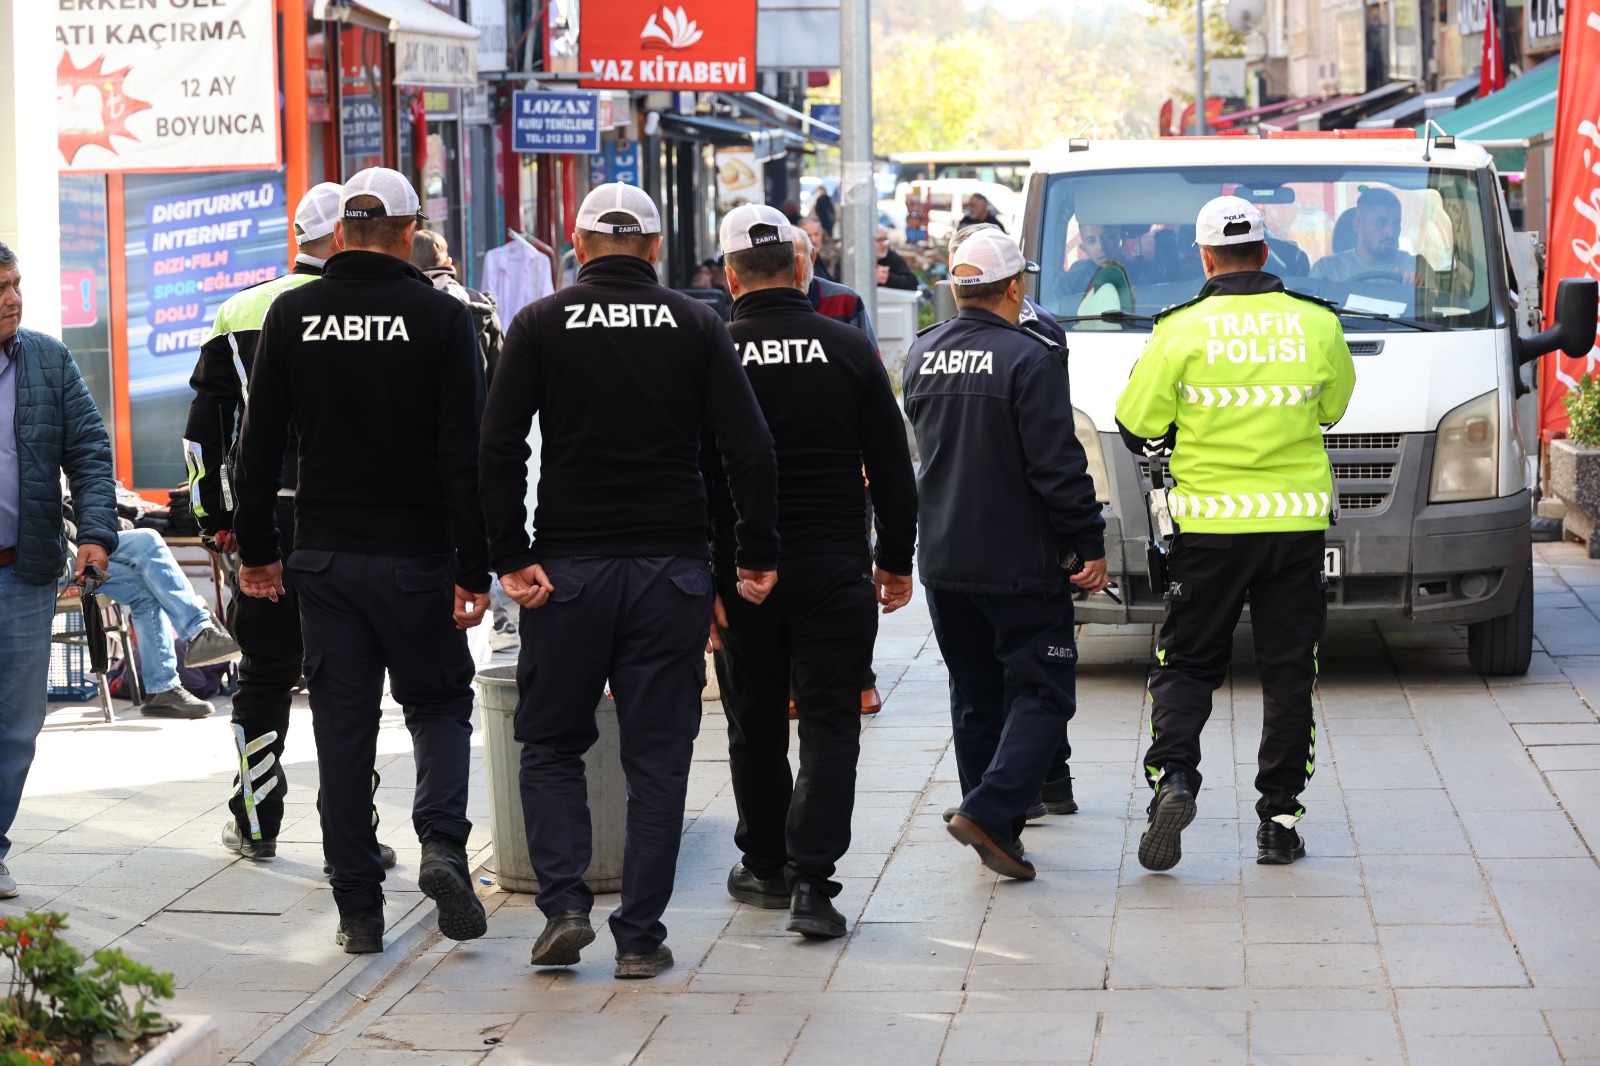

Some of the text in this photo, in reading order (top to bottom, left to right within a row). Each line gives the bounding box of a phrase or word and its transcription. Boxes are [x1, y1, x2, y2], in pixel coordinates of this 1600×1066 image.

[106, 19, 247, 50] KAÇIRMA
[590, 55, 747, 84] YAZ KİTABEVİ
[182, 76, 236, 97] 12 AY
[523, 99, 590, 115] LOZAN
[156, 114, 264, 137] BOYUNCA
[345, 209, 368, 217] ZABITA
[755, 235, 778, 244] ZABITA
[154, 267, 277, 300] SPOR EĞLENCE
[155, 303, 198, 324] DOLU
[564, 303, 678, 329] ZABITA
[302, 315, 410, 342] ZABITA
[734, 339, 829, 366] ABITA
[919, 350, 993, 375] ZABITA
[1047, 646, 1074, 659] ZABITA
